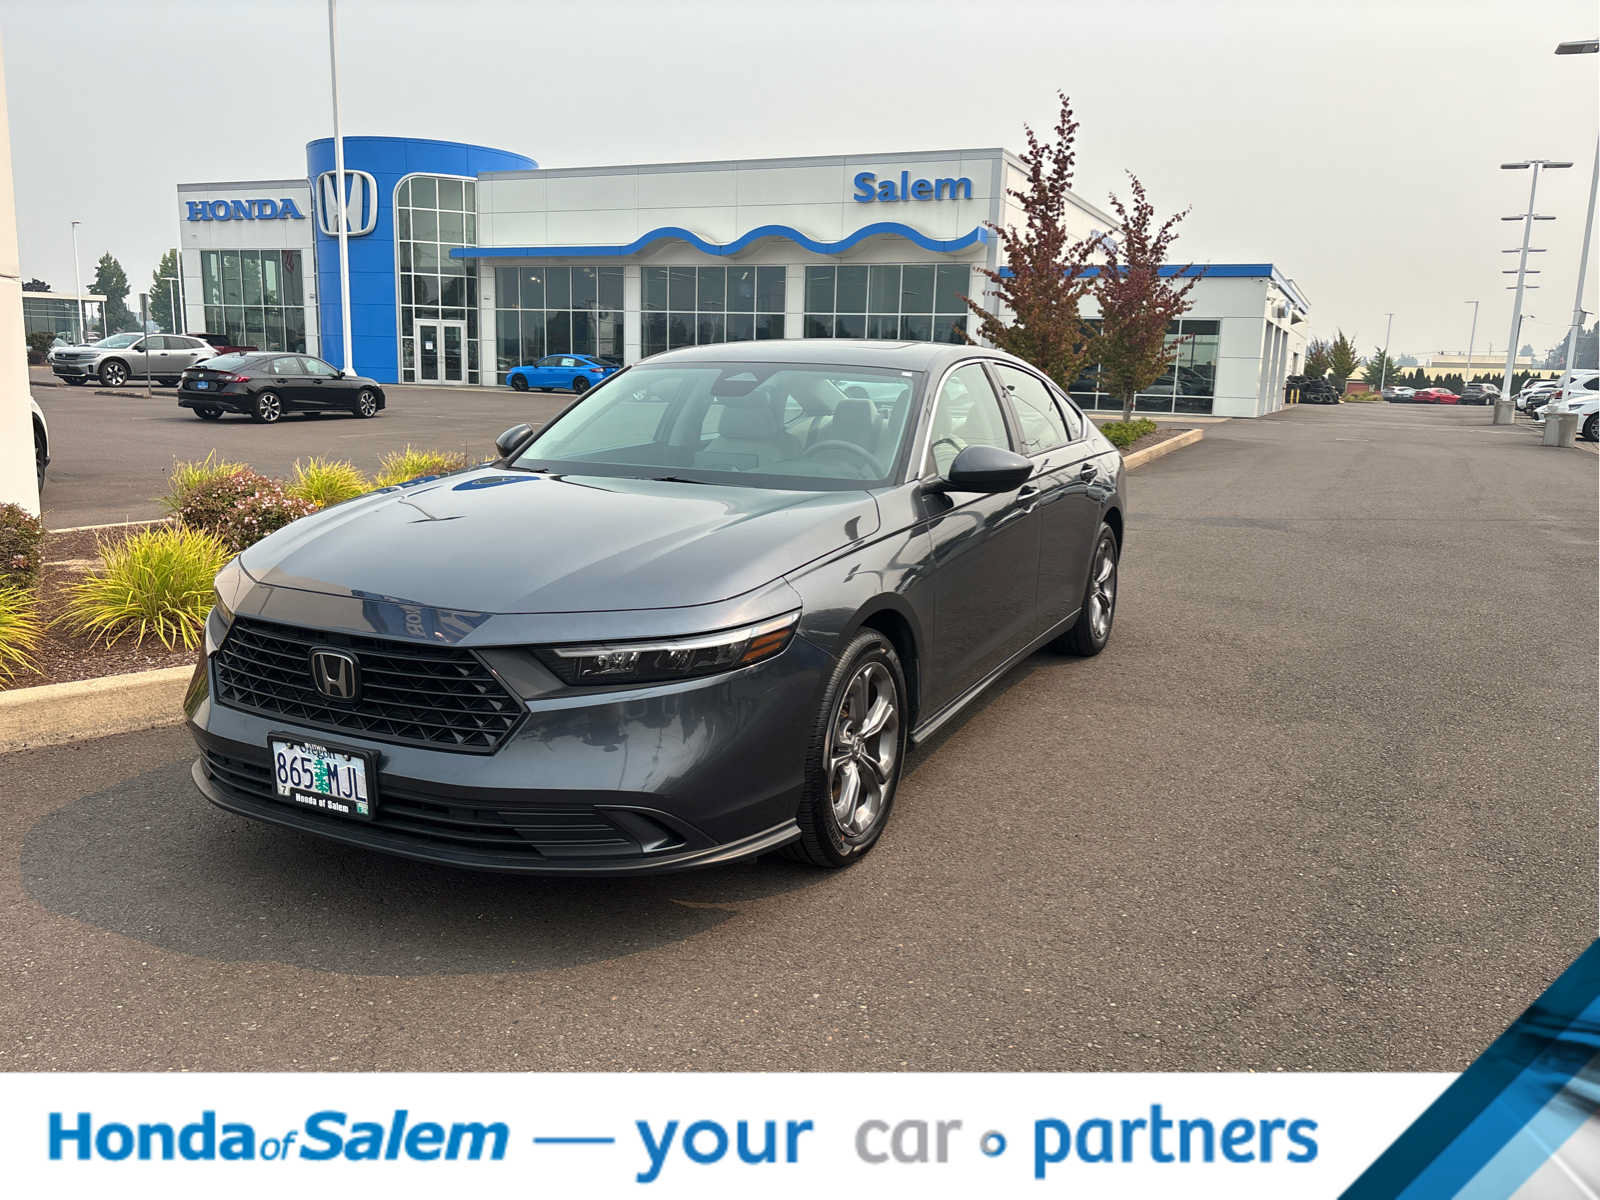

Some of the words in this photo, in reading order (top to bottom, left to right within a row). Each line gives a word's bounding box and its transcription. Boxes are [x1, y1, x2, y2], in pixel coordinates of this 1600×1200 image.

[853, 170, 971, 203] Salem
[186, 198, 304, 221] HONDA
[277, 752, 314, 789] 865
[326, 762, 367, 803] MJL
[295, 793, 317, 806] Honda
[318, 799, 326, 809] of
[327, 801, 349, 813] Salem
